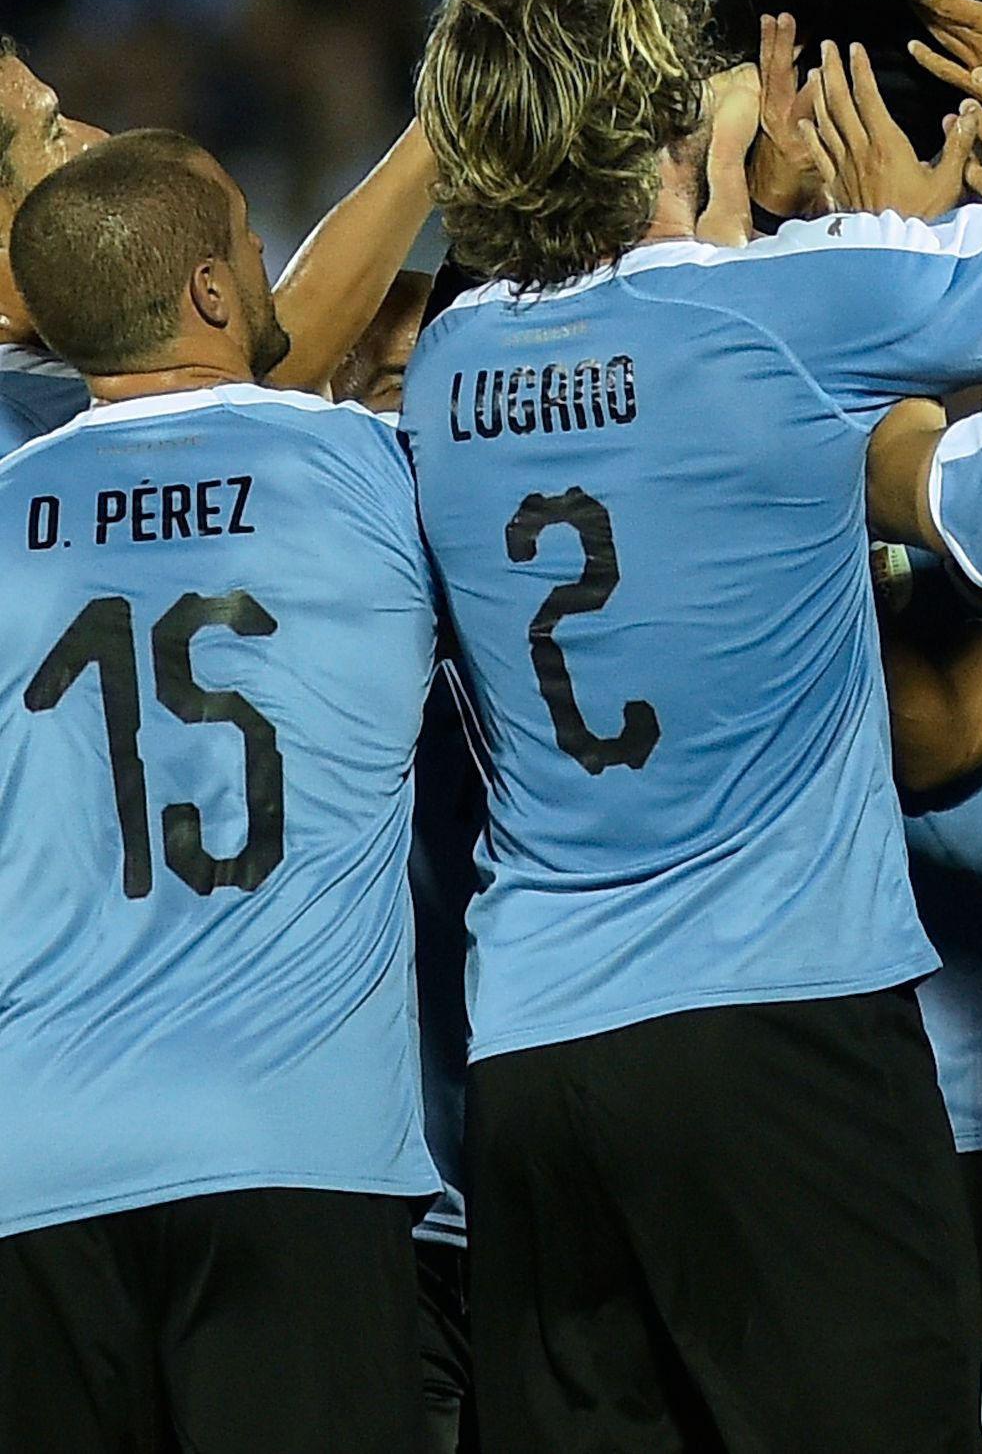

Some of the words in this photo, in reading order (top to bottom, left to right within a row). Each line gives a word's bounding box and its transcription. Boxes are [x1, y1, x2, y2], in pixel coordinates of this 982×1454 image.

[450, 354, 637, 441] LUGANO
[28, 495, 72, 549] D.
[96, 476, 255, 545] PÉREZ
[505, 485, 661, 775] 2
[24, 588, 285, 899] 15
